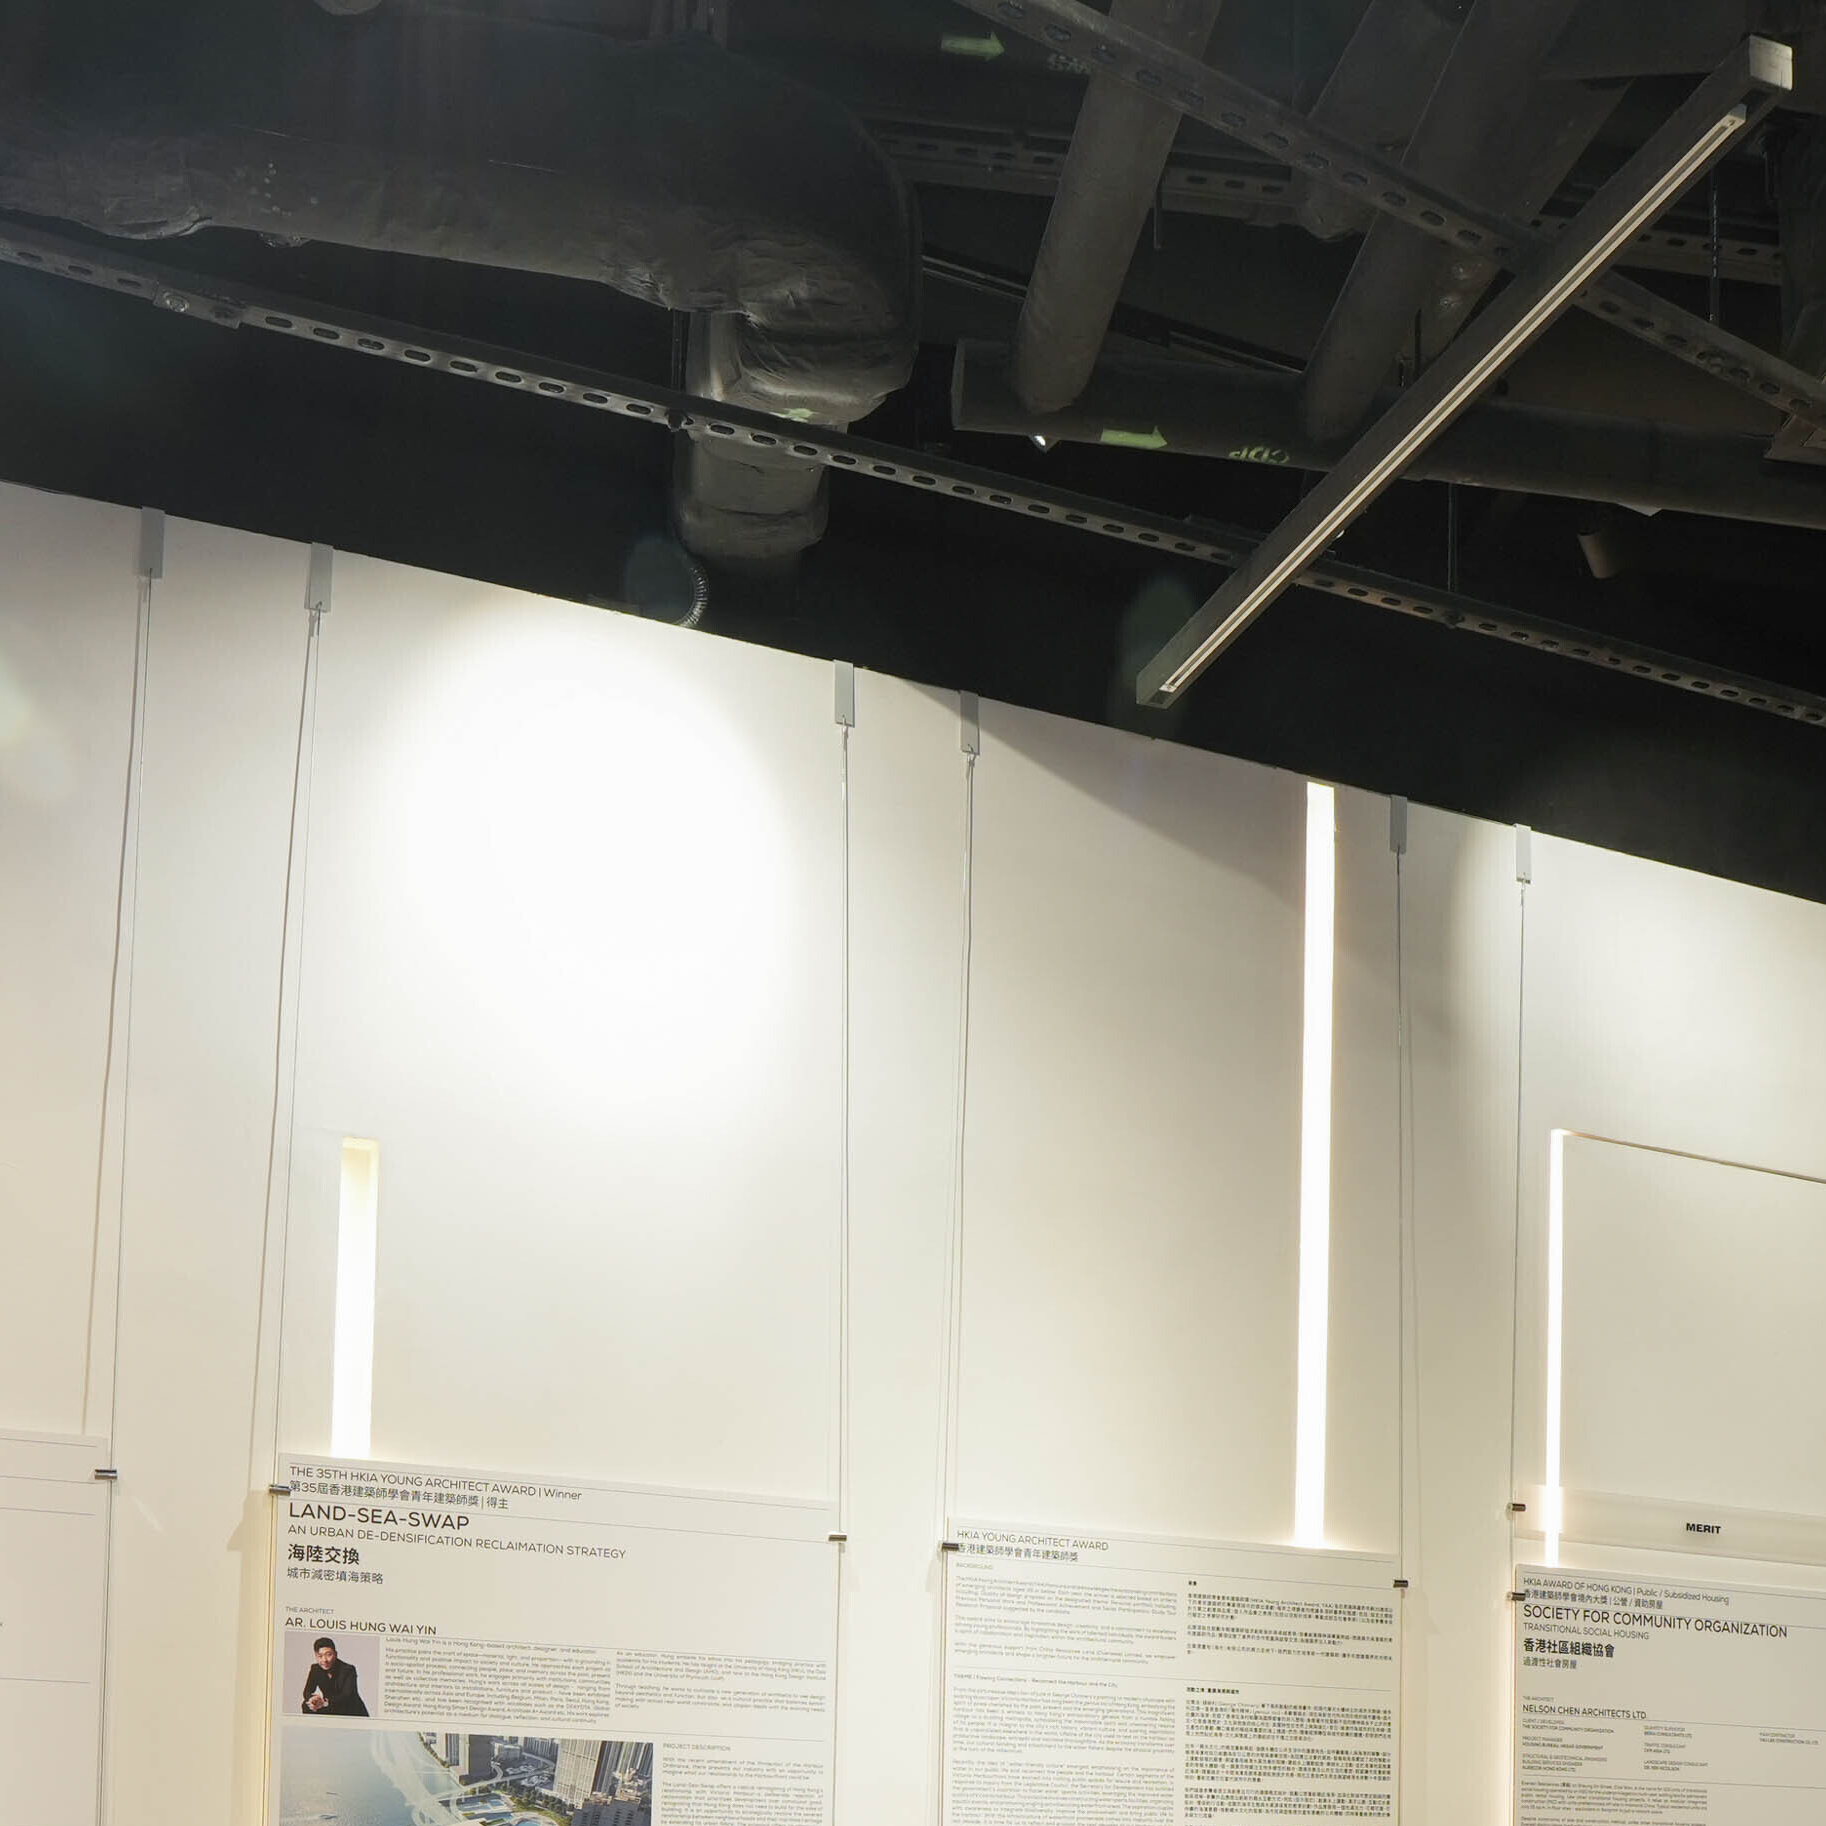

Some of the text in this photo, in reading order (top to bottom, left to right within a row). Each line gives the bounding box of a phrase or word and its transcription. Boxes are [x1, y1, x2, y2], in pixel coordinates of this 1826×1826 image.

[290, 1465, 313, 1477] THE
[316, 1467, 347, 1480] 35TH
[350, 1471, 378, 1482] HKIA
[380, 1473, 422, 1486] YOUNG
[424, 1477, 489, 1491] ARCHITECT
[491, 1483, 536, 1496] AWARD
[543, 1487, 582, 1500] Winner
[289, 1502, 469, 1530] LAND-SEA-SWAP
[1686, 1522, 1721, 1534] MERIT
[287, 1524, 626, 1558] AN URBAN DE-DENSIFICATION RECLAIMATION STRATEGY
[957, 1530, 1108, 1550] HKIA YOUNG ARCHITECT AWARD
[287, 1543, 359, 1565] 海陸交換
[286, 1566, 383, 1584] 城市減密填海策略
[1523, 1577, 1729, 1605] HKIA AWARD OF HONG KONG Public Subsidized Housing
[285, 1605, 298, 1613] THE
[285, 1616, 436, 1635] AR. LOUIS HUNG WAI YIN
[1523, 1603, 1786, 1637] SOCIETY FOR COMMUNITY ORGANIZATION
[1523, 1621, 1649, 1640] TRANSITIONAL SOCIAL HOUSING
[1523, 1637, 1614, 1657] 香港社區組織協會
[1522, 1704, 1555, 1714] NELSON
[1557, 1705, 1580, 1715] CHEN
[1581, 1707, 1630, 1718] ARCHITECTS
